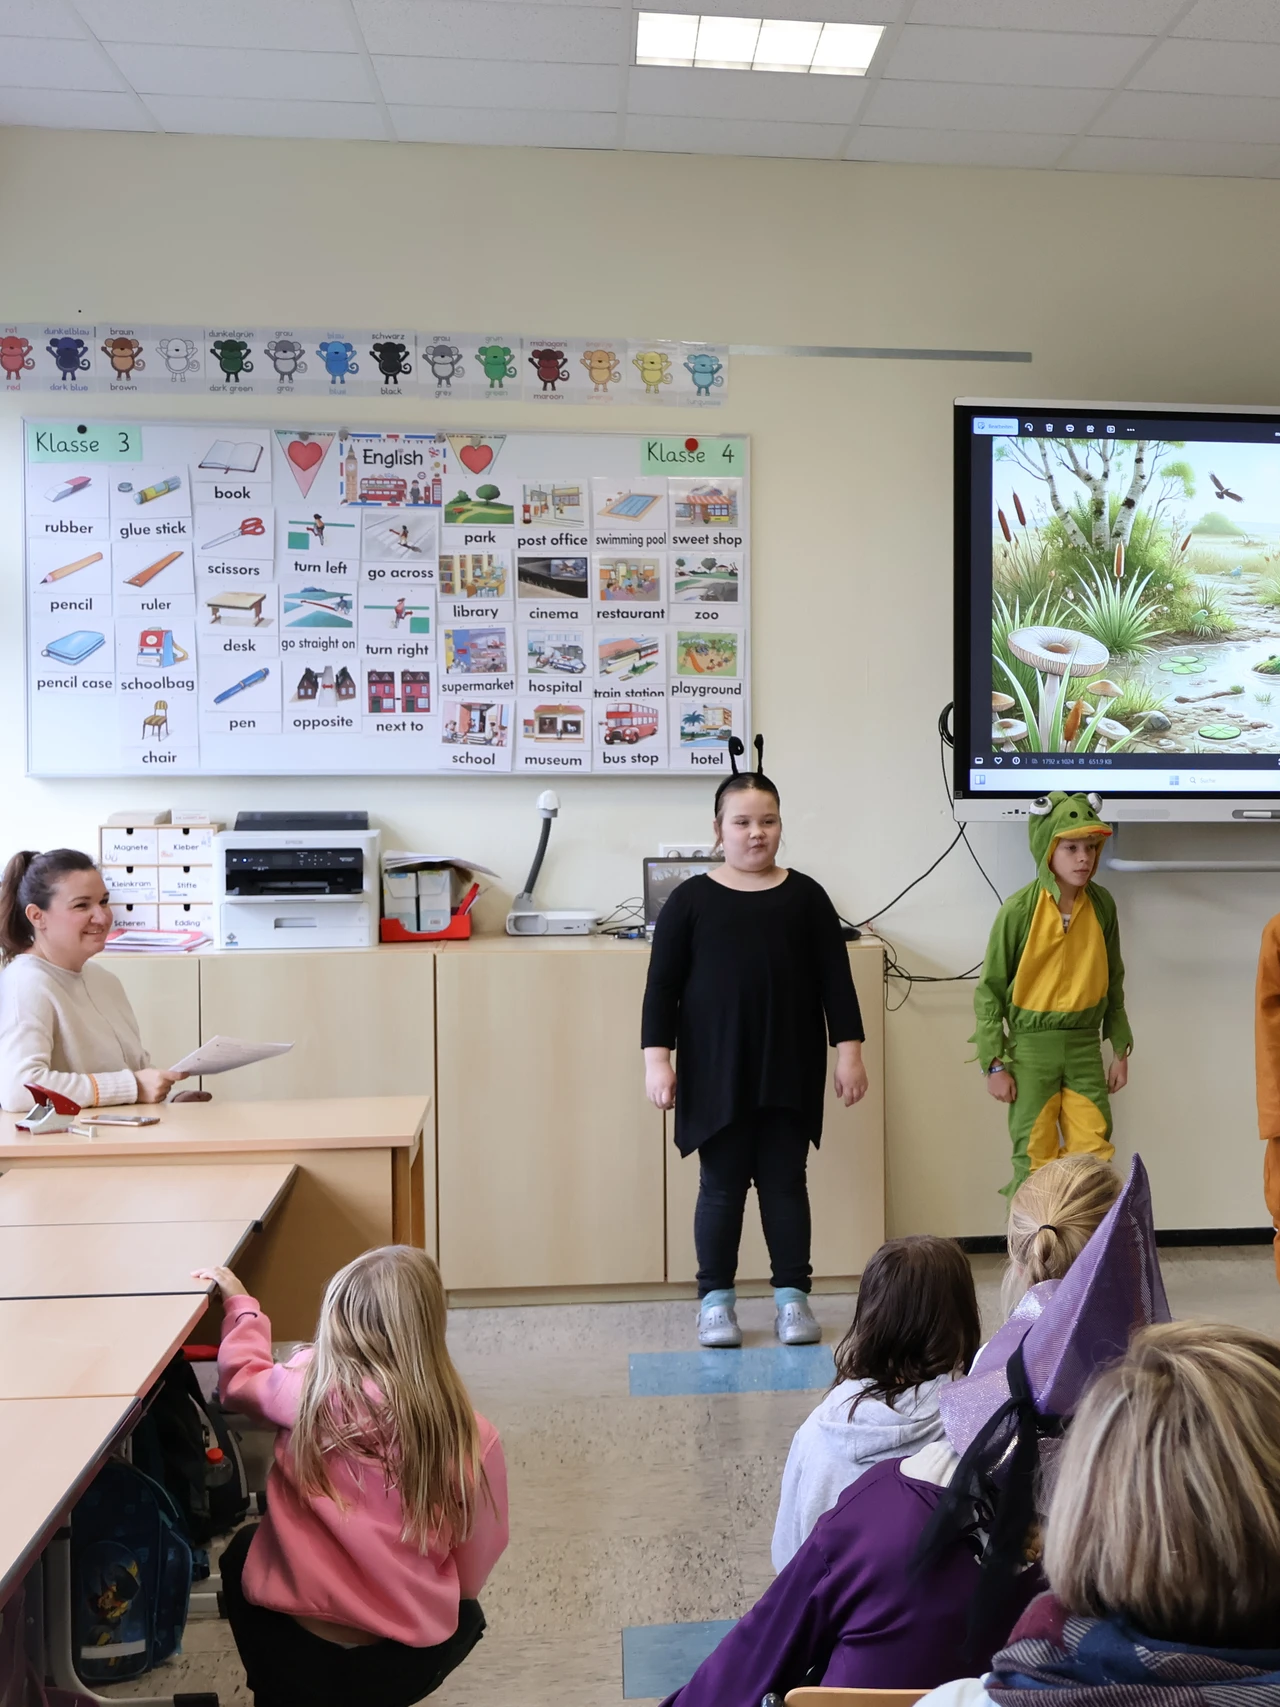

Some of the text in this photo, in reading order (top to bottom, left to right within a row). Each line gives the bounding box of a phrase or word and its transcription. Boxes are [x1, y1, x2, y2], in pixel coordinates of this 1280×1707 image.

[44, 328, 90, 336] dunkelblau
[110, 328, 134, 336] braun
[208, 330, 254, 339] dunkelgrün
[275, 330, 293, 338] grau
[328, 332, 344, 340] blau
[372, 332, 405, 340] schwarz
[433, 336, 450, 344] grau
[209, 384, 254, 394] dark green
[380, 387, 402, 395] black
[36, 432, 130, 454] Klasse 3
[362, 448, 424, 468] English
[647, 442, 735, 464] Klasse 4
[214, 486, 251, 500] book
[44, 521, 94, 534] rubber
[120, 522, 187, 537] glue stick
[464, 532, 496, 546] park
[517, 533, 588, 550] post office
[596, 532, 666, 551] swimming pool
[672, 532, 742, 551] sweet shop
[208, 564, 260, 576] scissors
[294, 560, 348, 574] turn left
[368, 568, 434, 581] go across
[50, 598, 93, 613] pencil
[140, 599, 172, 611] ruler
[453, 605, 498, 620] library
[529, 608, 578, 620] cinema
[596, 608, 665, 620] restaurant
[694, 610, 719, 620] zoo
[223, 639, 256, 652] desk
[281, 638, 356, 652] go straight on
[366, 644, 429, 658] turn right
[37, 677, 113, 691] pencil case
[120, 676, 195, 692] schoolbag
[442, 679, 514, 694] supermarket
[528, 680, 582, 694] hospital
[672, 682, 742, 697] playground
[594, 686, 665, 698] train station
[229, 718, 256, 731] pen
[292, 716, 353, 730] opposite
[376, 722, 424, 732] next to
[142, 751, 177, 764] chair
[452, 752, 496, 766] school
[524, 756, 582, 766] museum
[602, 752, 659, 766] bus stop
[690, 752, 724, 765] hotel
